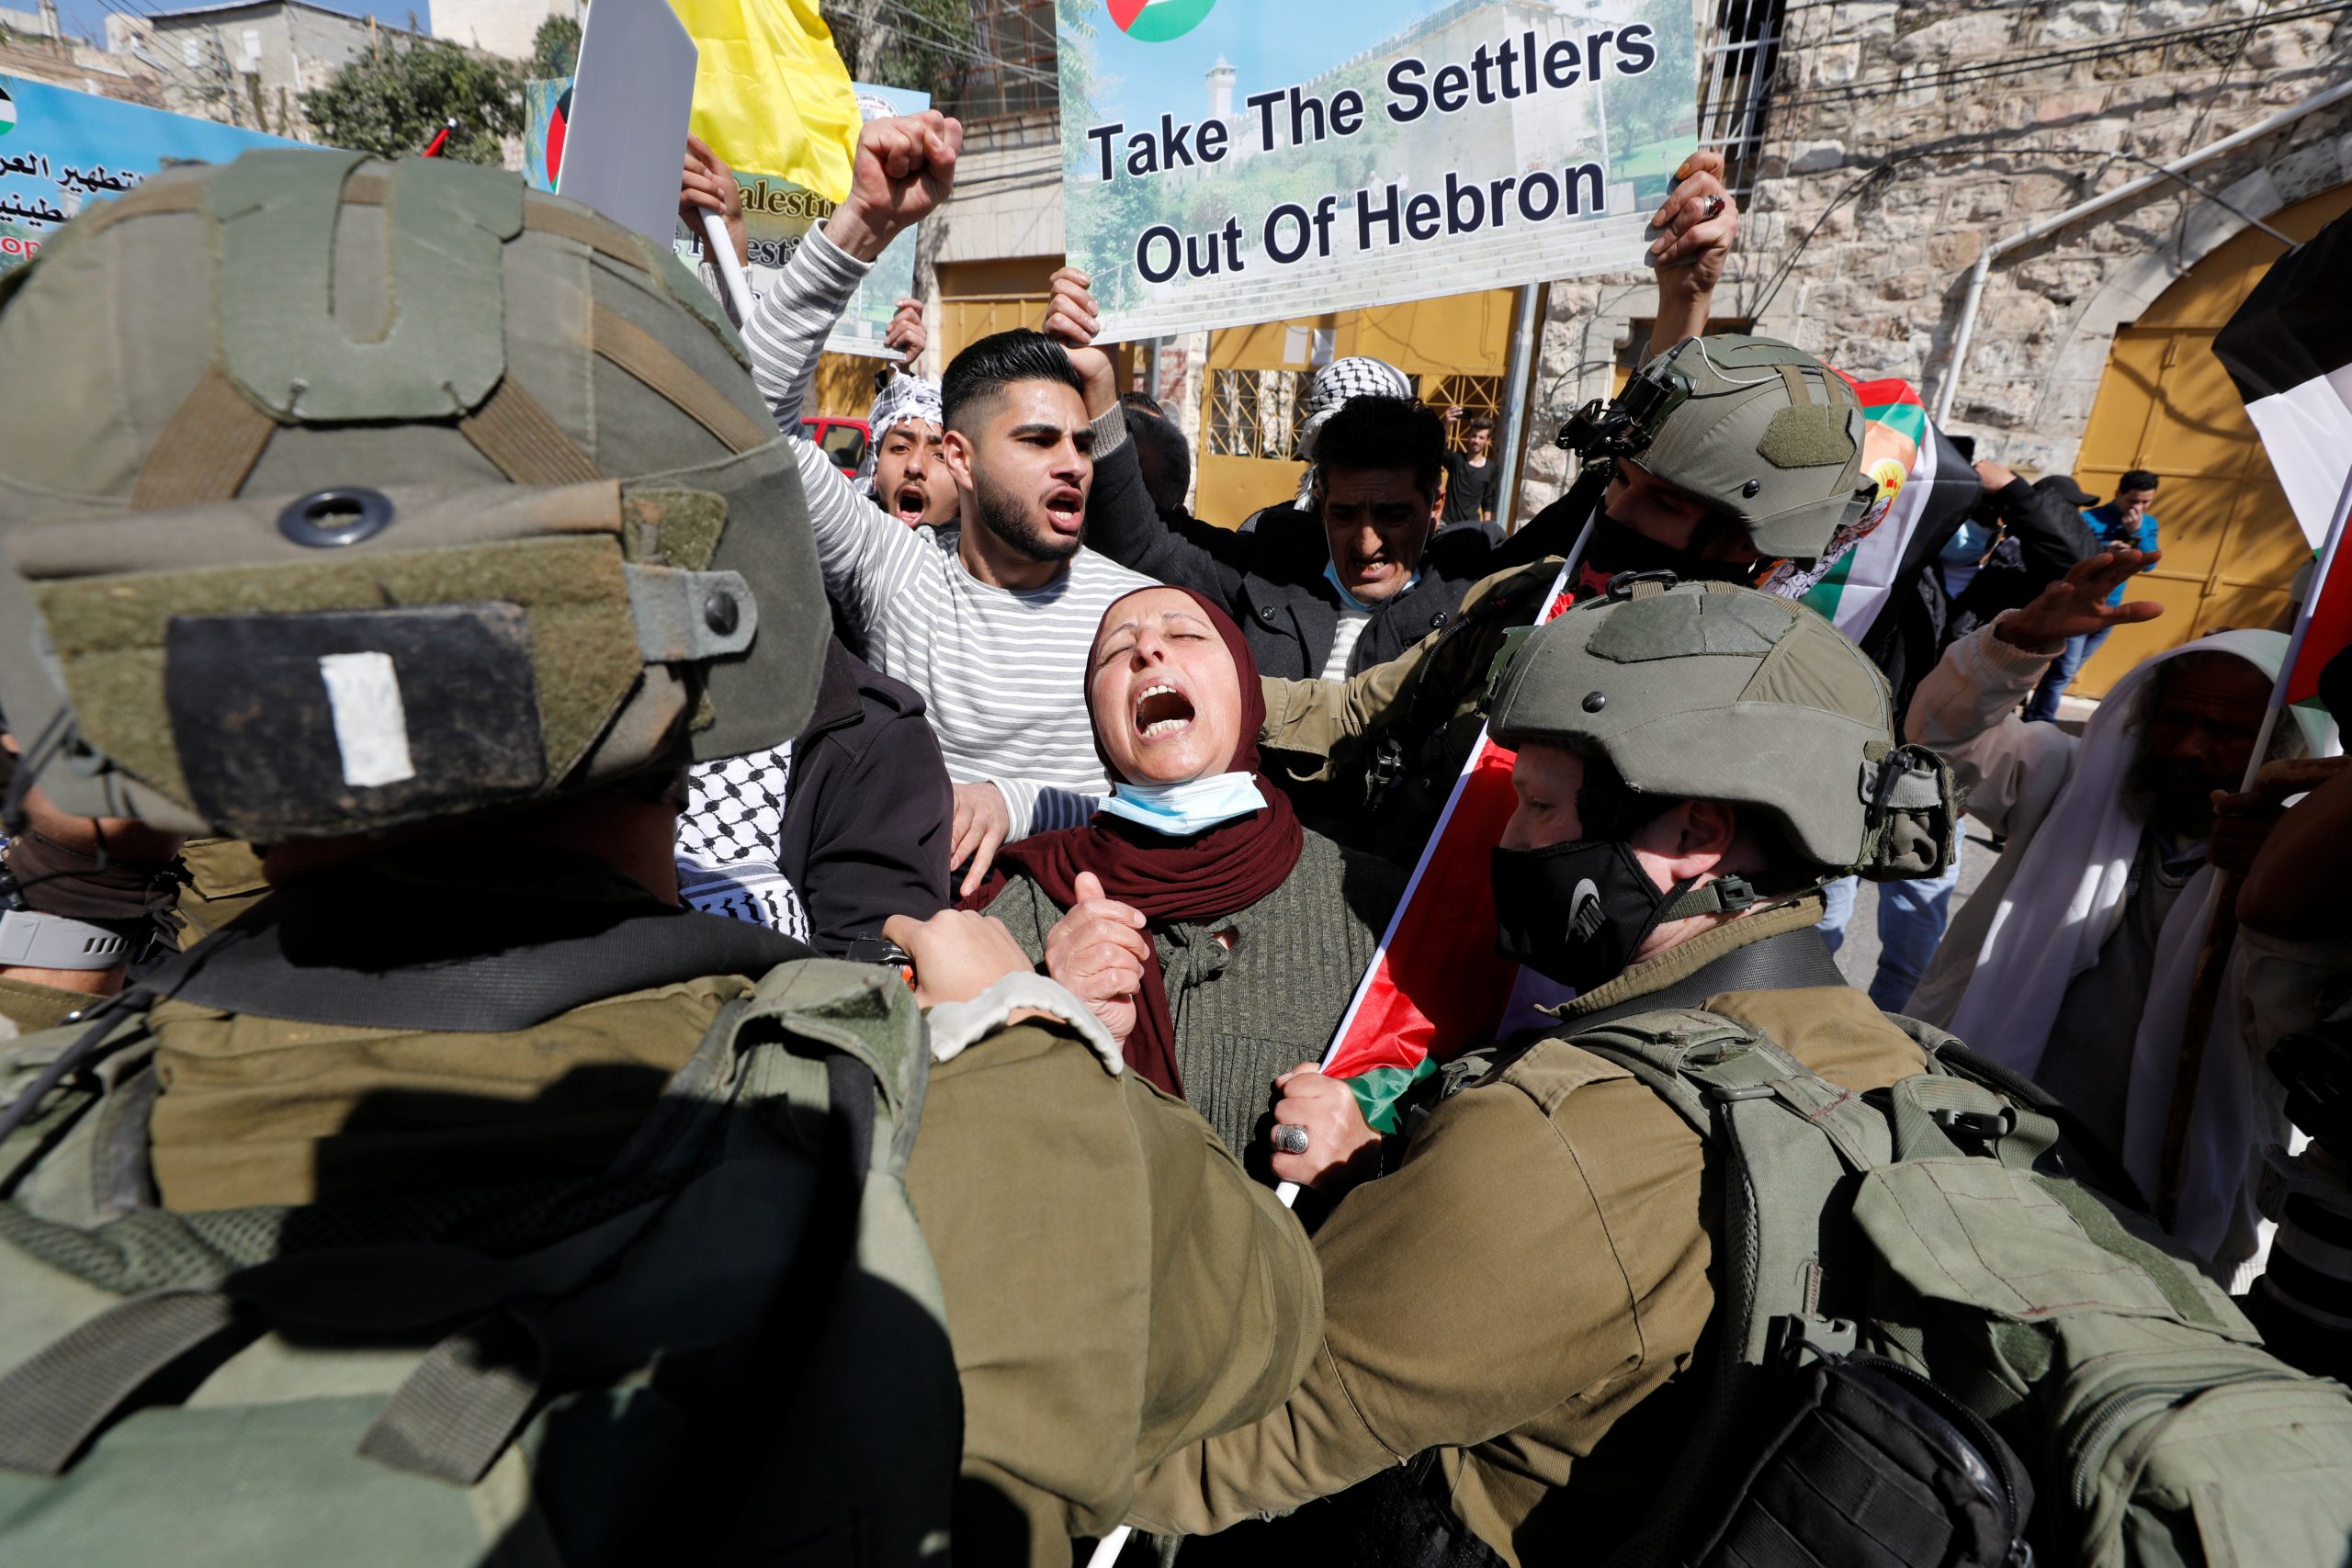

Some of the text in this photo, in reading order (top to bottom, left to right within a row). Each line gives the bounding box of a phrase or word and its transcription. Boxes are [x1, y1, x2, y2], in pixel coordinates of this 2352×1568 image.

[1088, 24, 1656, 182] Take The Settlers
[736, 179, 838, 219] alesti
[1136, 163, 1605, 284] Out Of Hebron
[1574, 897, 1607, 943] NIKE
